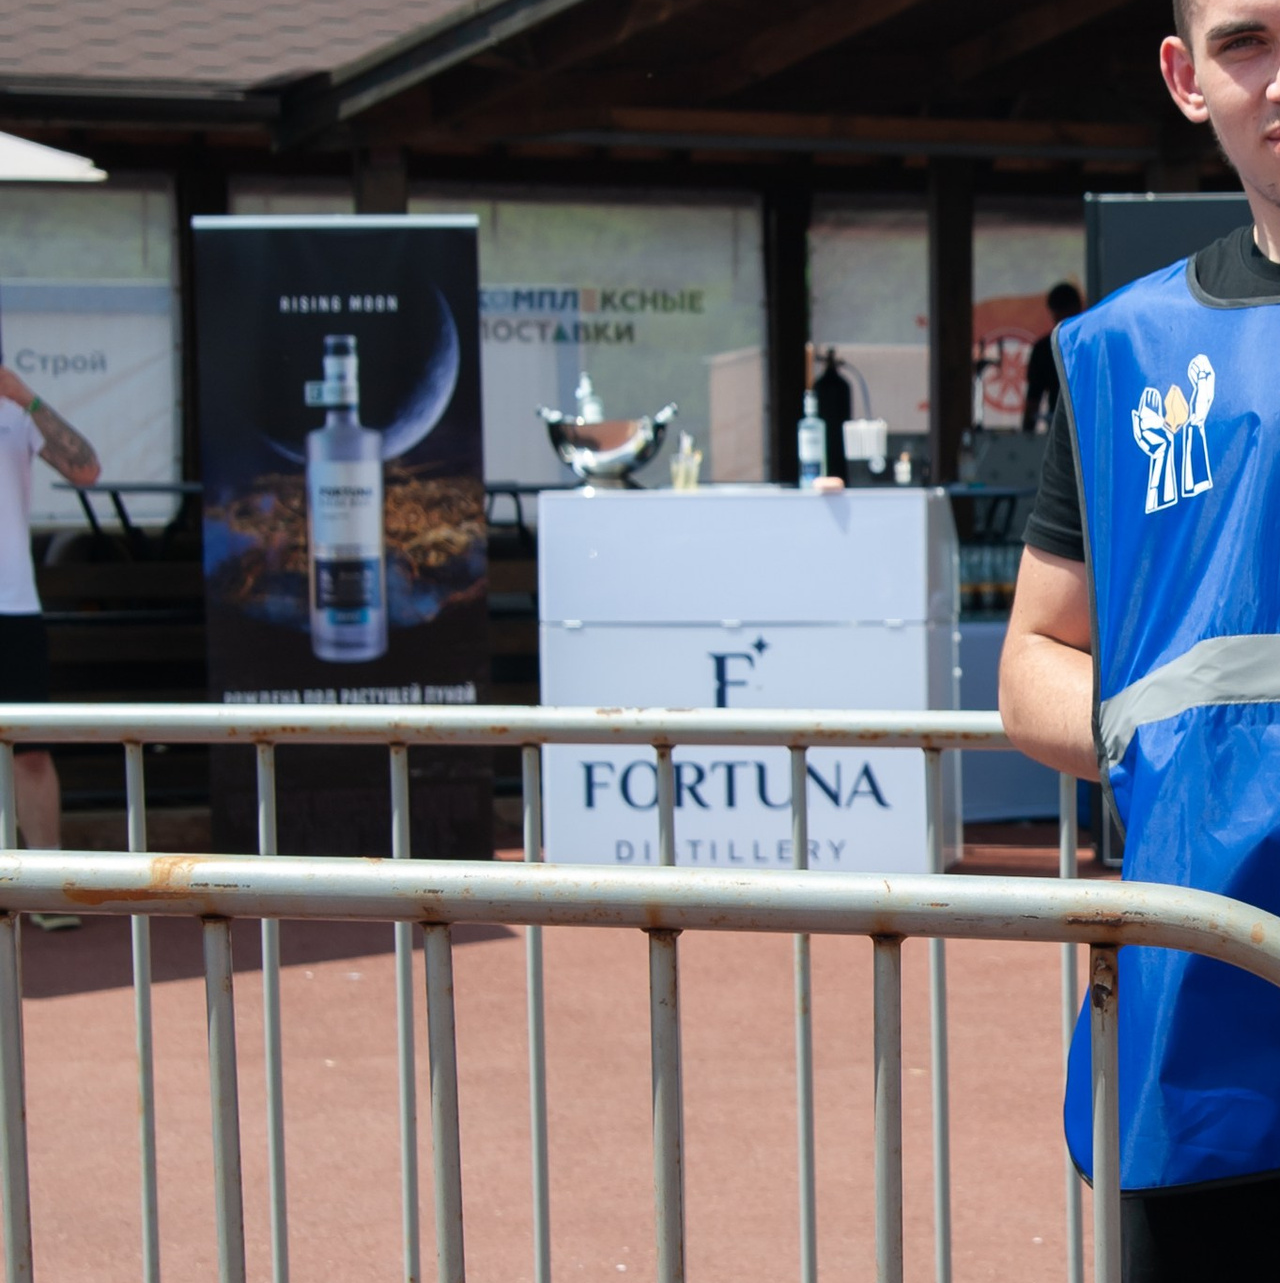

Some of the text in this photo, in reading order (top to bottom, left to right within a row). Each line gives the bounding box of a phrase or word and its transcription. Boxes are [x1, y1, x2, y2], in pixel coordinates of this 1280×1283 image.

[280, 295, 398, 313] RISING MOON
[16, 348, 107, 378] Строй
[580, 759, 892, 810] FORTUNA
[615, 839, 847, 863] DITILLERY
